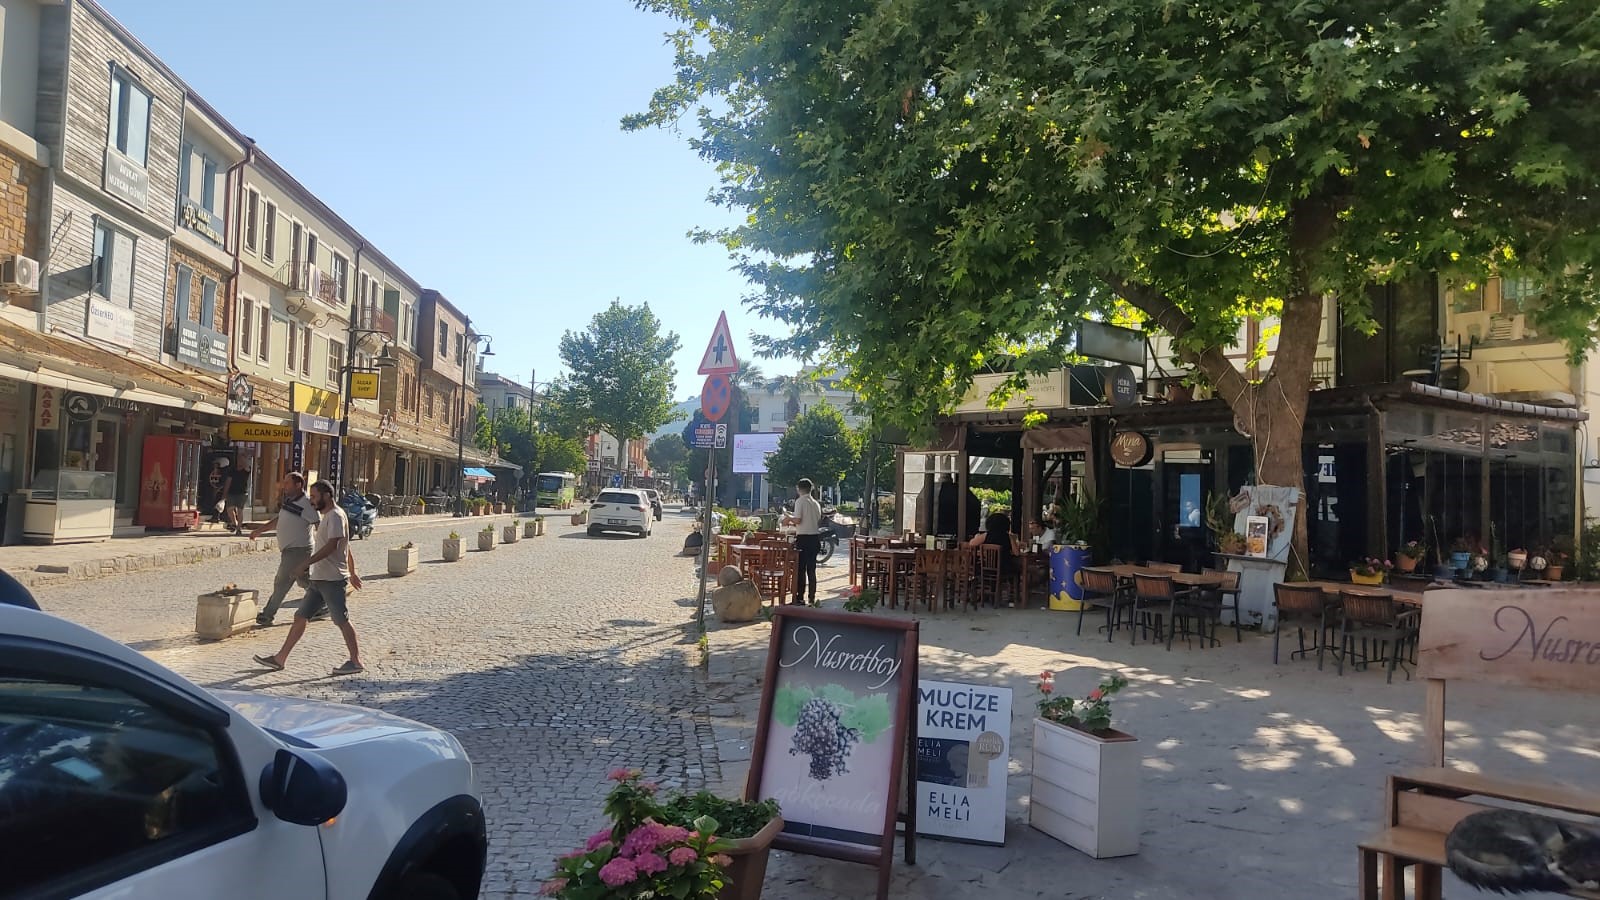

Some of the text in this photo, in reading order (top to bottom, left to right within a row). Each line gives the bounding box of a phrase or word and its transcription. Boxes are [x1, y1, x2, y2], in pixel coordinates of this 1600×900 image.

[244, 428, 271, 436] ALCAN
[779, 625, 902, 690] Nusretbey
[917, 688, 999, 712] MUCİZE
[926, 709, 987, 731] KREM
[930, 792, 970, 807] ELIA
[929, 806, 970, 821] MELI
